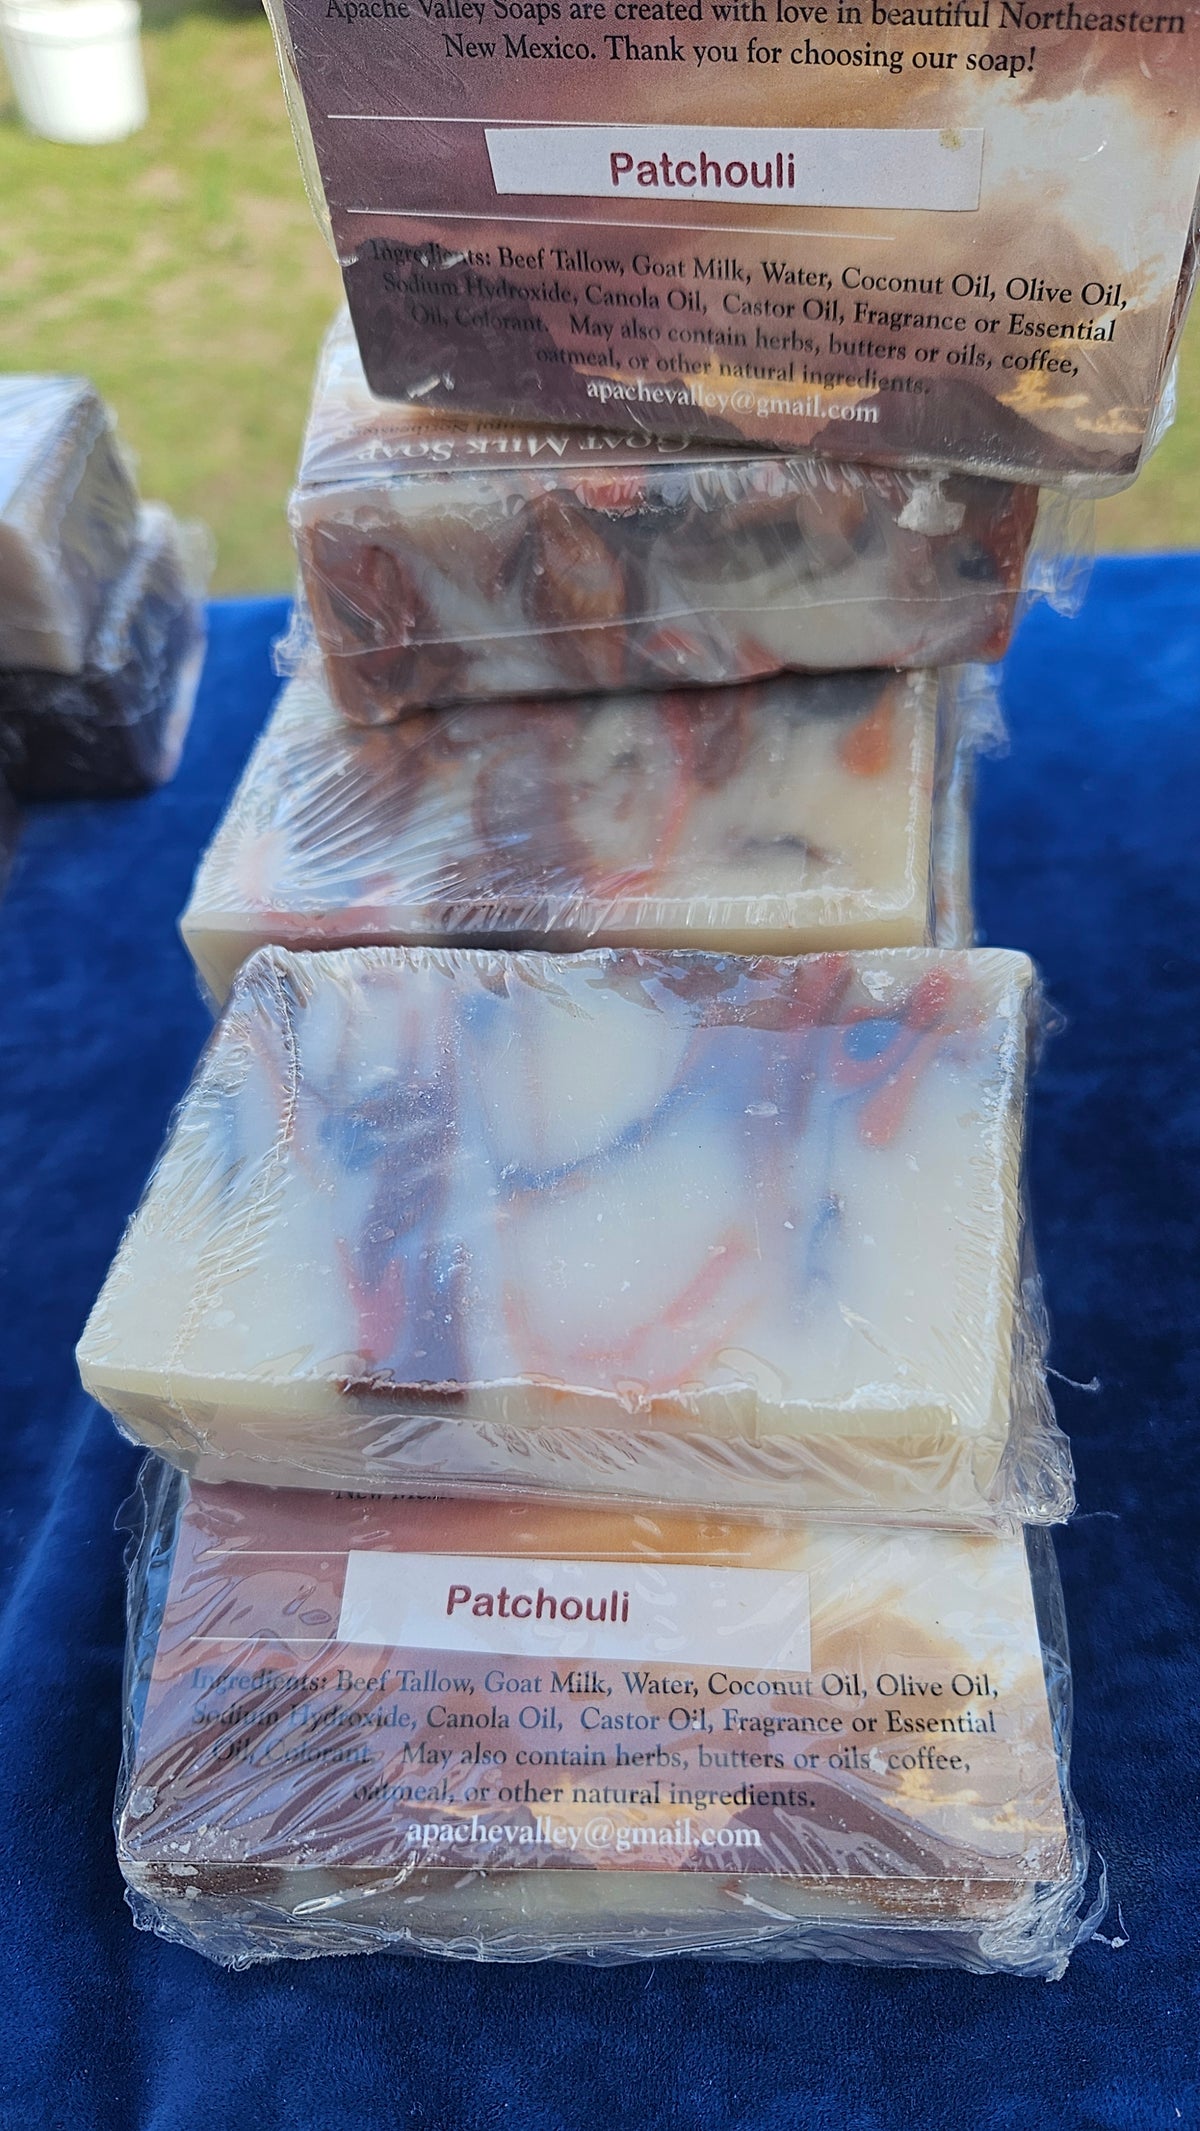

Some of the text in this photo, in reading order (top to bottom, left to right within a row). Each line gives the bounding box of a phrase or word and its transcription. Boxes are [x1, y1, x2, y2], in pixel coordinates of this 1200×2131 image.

[326, 0, 1185, 33] Apache Valley Soaps are created with love in beautiful Northeastern
[441, 33, 1037, 78] New Mexico. Thank you for choosing our soap!
[609, 151, 796, 189] Patchouli
[499, 247, 546, 269] Beef
[550, 250, 625, 276] Tallow,
[632, 255, 686, 278] Goat
[693, 258, 751, 285] Milk,
[760, 262, 833, 289] Water,
[842, 267, 944, 295] Coconut
[952, 274, 996, 301] Oil,
[1006, 278, 1073, 304] Olive
[1081, 282, 1128, 310] Oil,
[384, 275, 1115, 342] Sodium Hydroxide, Canola Oil, Castor Oil, Fragrance or Essential
[411, 305, 1079, 377] Oil, Colorant. May also contain herbs, butters or oils, coffee,
[536, 345, 931, 396] oatmeal, or other natural ingredients.
[587, 379, 880, 424] apachevalley@gmail.com
[358, 433, 692, 463] GOAT MILK SOAP
[447, 1584, 630, 1622] Patchouli
[191, 1667, 999, 1700] Ingredients: Beef Tallow, Goat Milk, Water, Coconut Oil, Olive Oil,
[192, 1705, 997, 1738] Sodium Hydroxide, Canola Oil, Castor Oil, Fragrance or Essential
[213, 1740, 255, 1765] Oil,
[402, 1743, 455, 1769] May
[461, 1742, 507, 1765] also
[515, 1745, 607, 1768] contain
[615, 1743, 689, 1770] herbs,
[699, 1744, 785, 1770] butters
[794, 1752, 820, 1770] or
[888, 1747, 971, 1773] coffee,
[465, 1786, 491, 1802] or
[498, 1778, 564, 1803] other
[572, 1781, 660, 1805] natural
[669, 1783, 816, 1811] ingredients.
[407, 1814, 762, 1848] apachevalley@gmail.com
